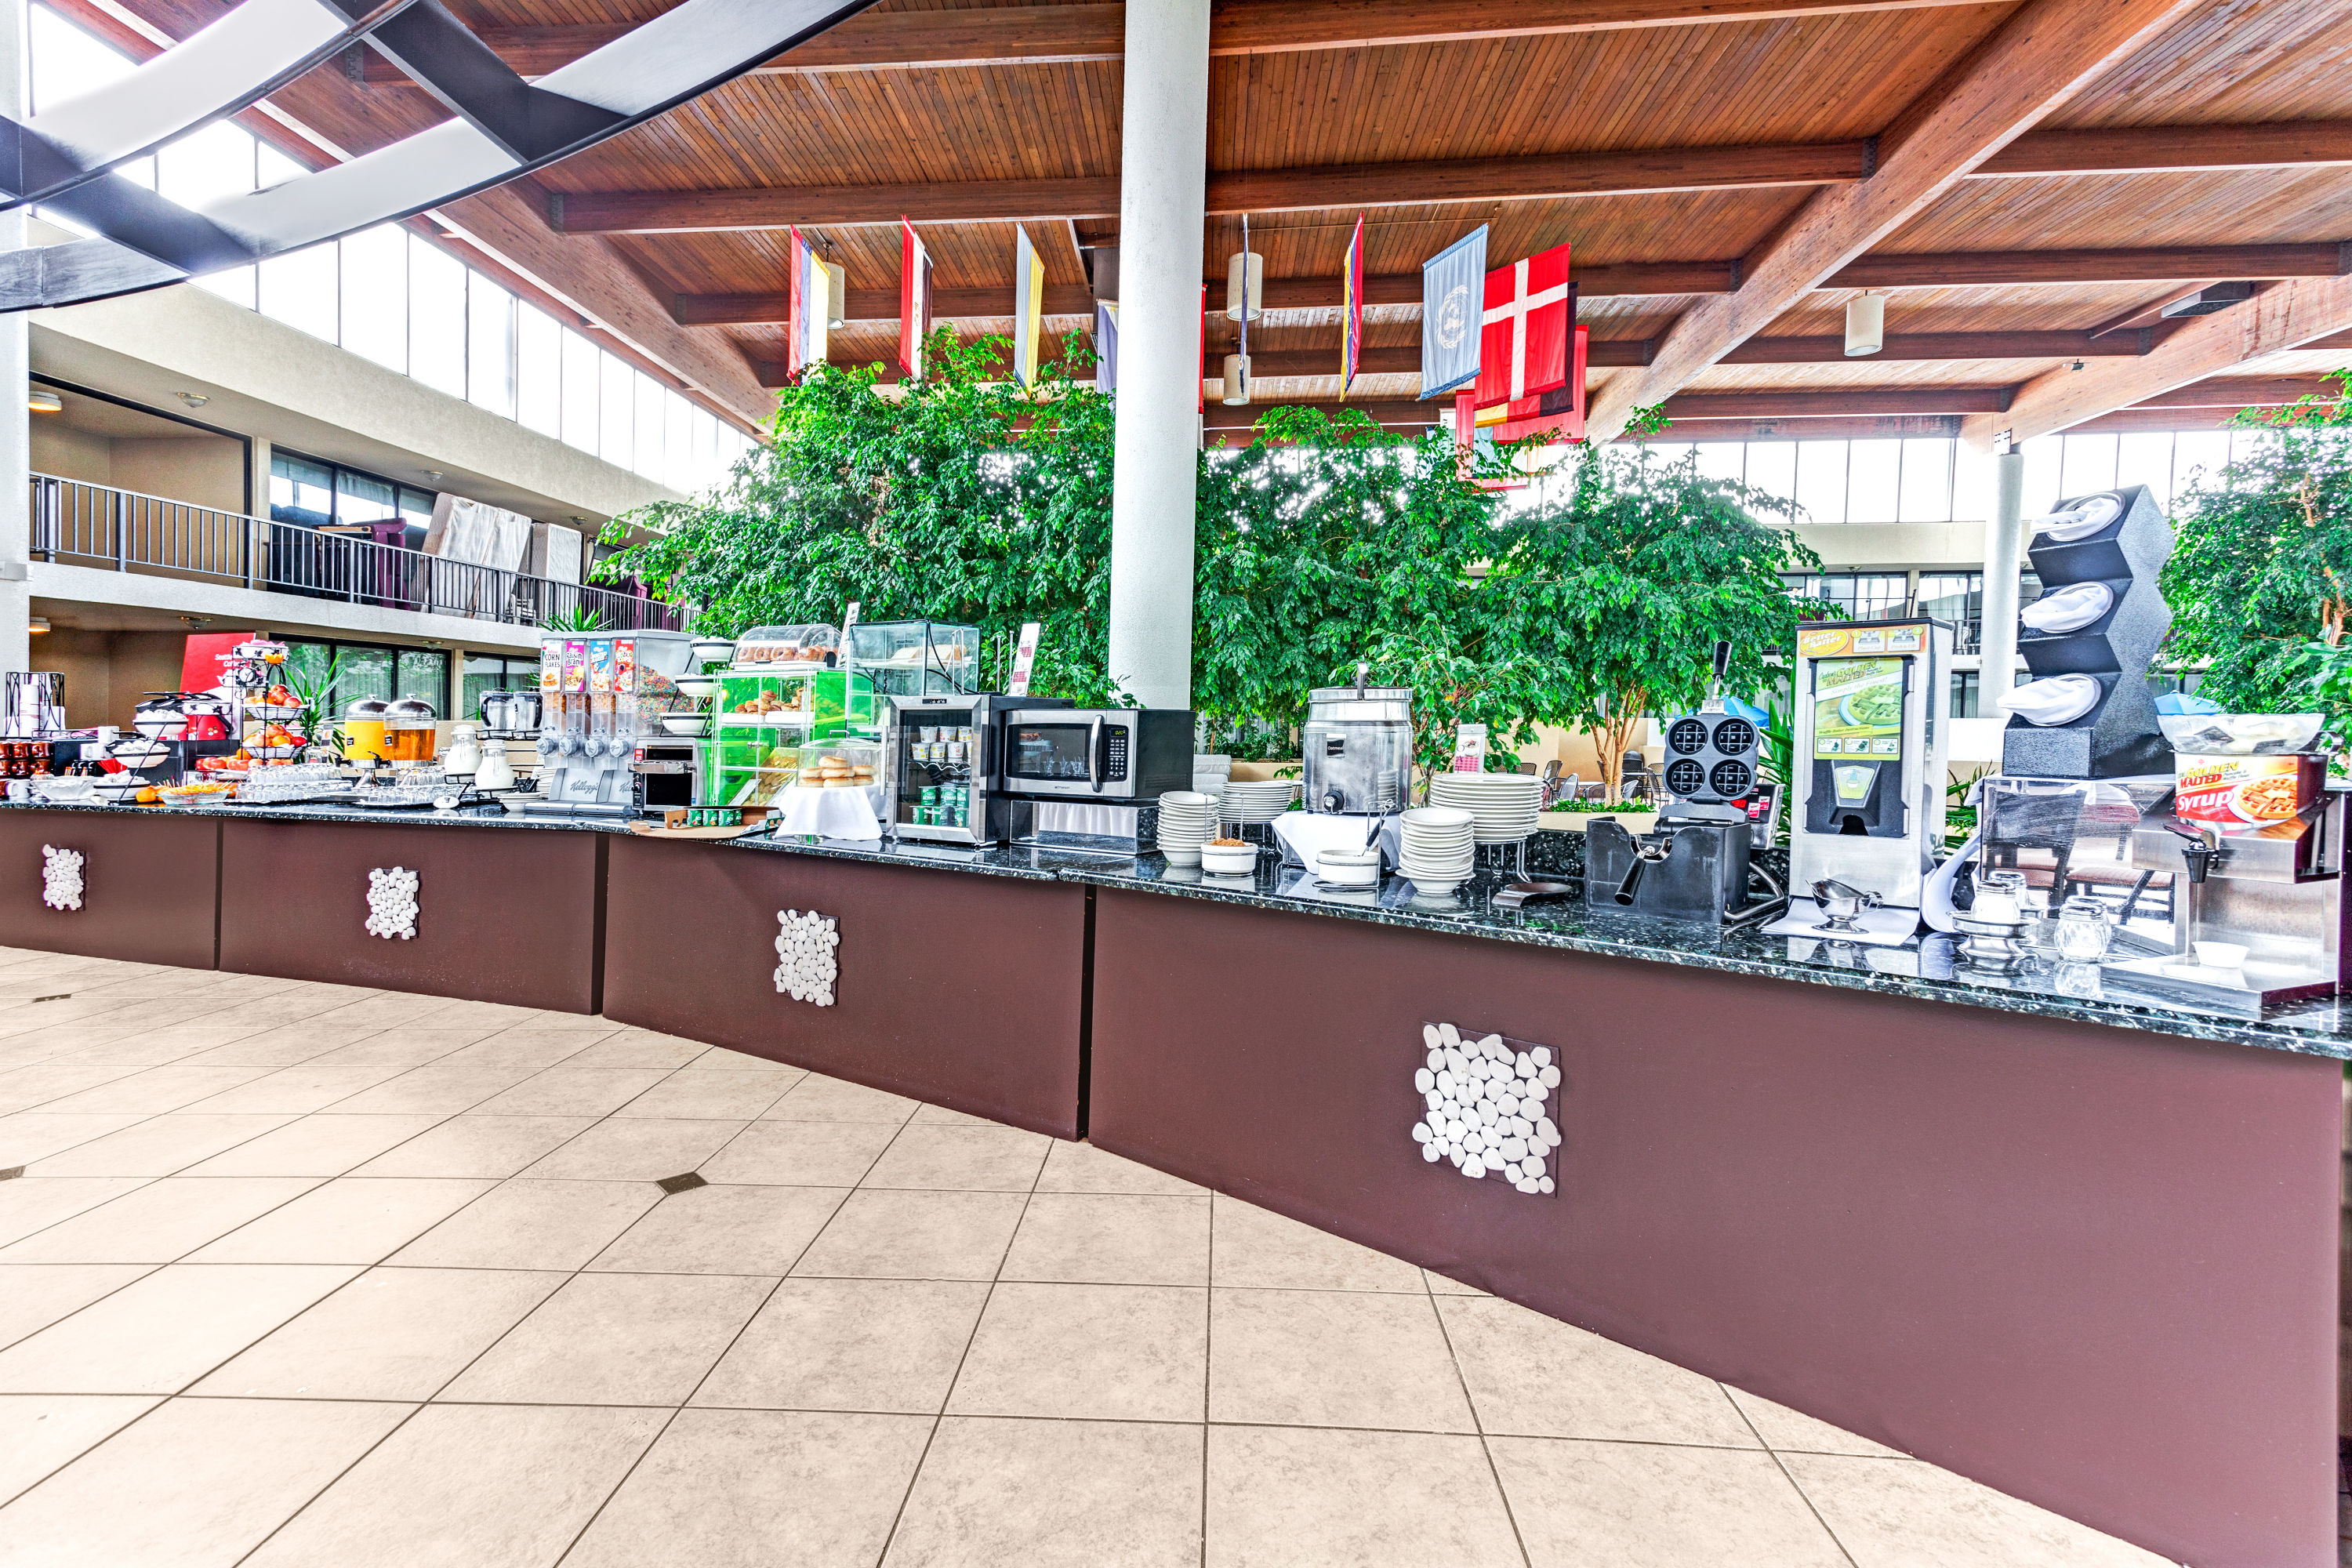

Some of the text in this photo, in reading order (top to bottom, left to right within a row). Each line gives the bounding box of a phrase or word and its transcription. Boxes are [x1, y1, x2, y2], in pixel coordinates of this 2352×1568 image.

[1803, 631, 1836, 644] Better
[1809, 635, 1842, 649] Batter
[1837, 660, 1878, 677] GOLDEN
[1827, 670, 1866, 686] MALTED
[2187, 761, 2239, 779] GOLDEN
[2180, 773, 2223, 788] MALTED
[2178, 790, 2234, 812] Syrup
